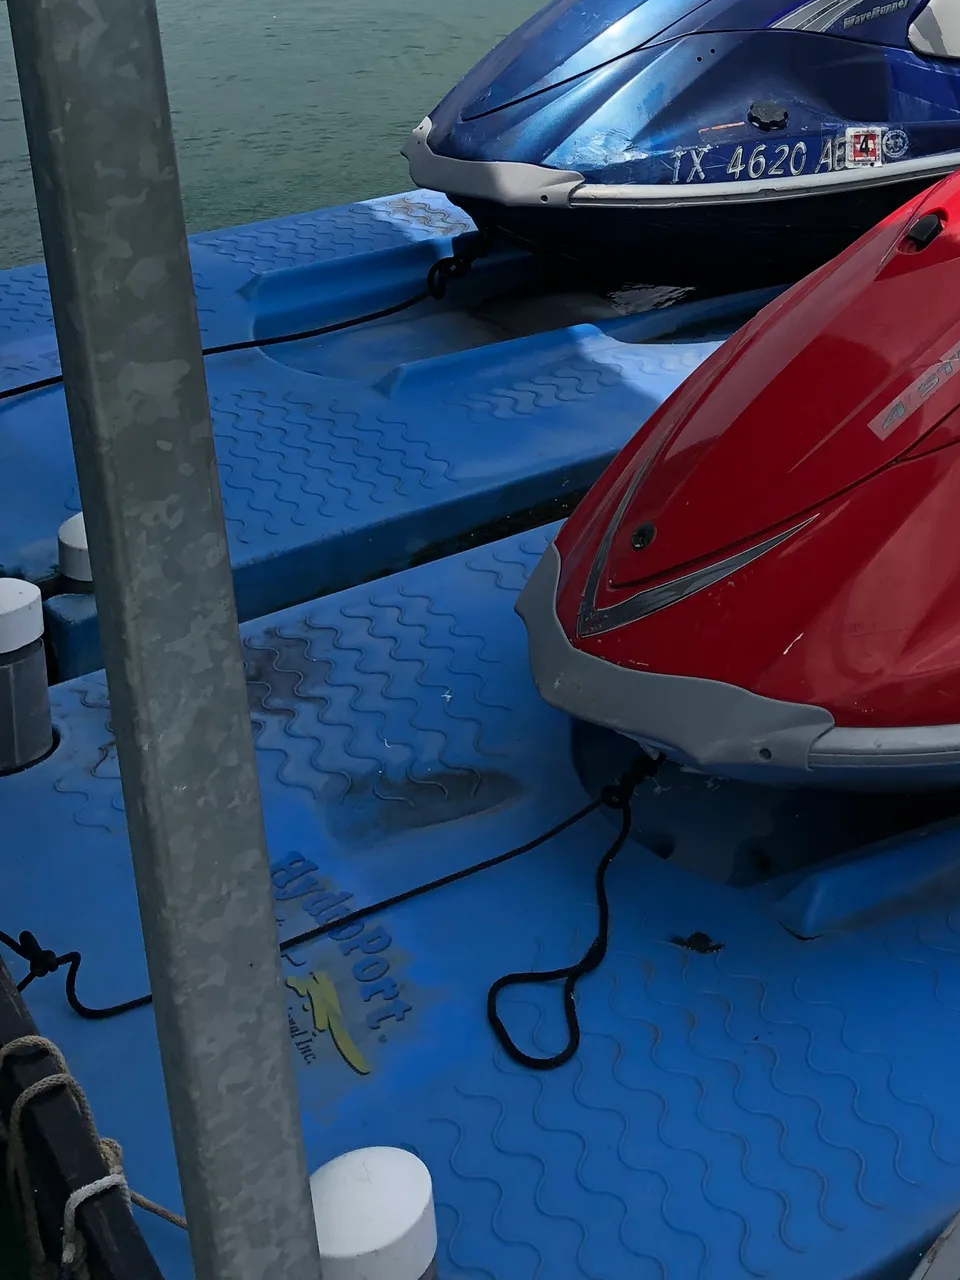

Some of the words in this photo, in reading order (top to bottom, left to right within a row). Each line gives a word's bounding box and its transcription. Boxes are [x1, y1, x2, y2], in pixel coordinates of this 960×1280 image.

[859, 135, 870, 157] 4
[670, 144, 711, 184] TX
[726, 141, 807, 180] 4620
